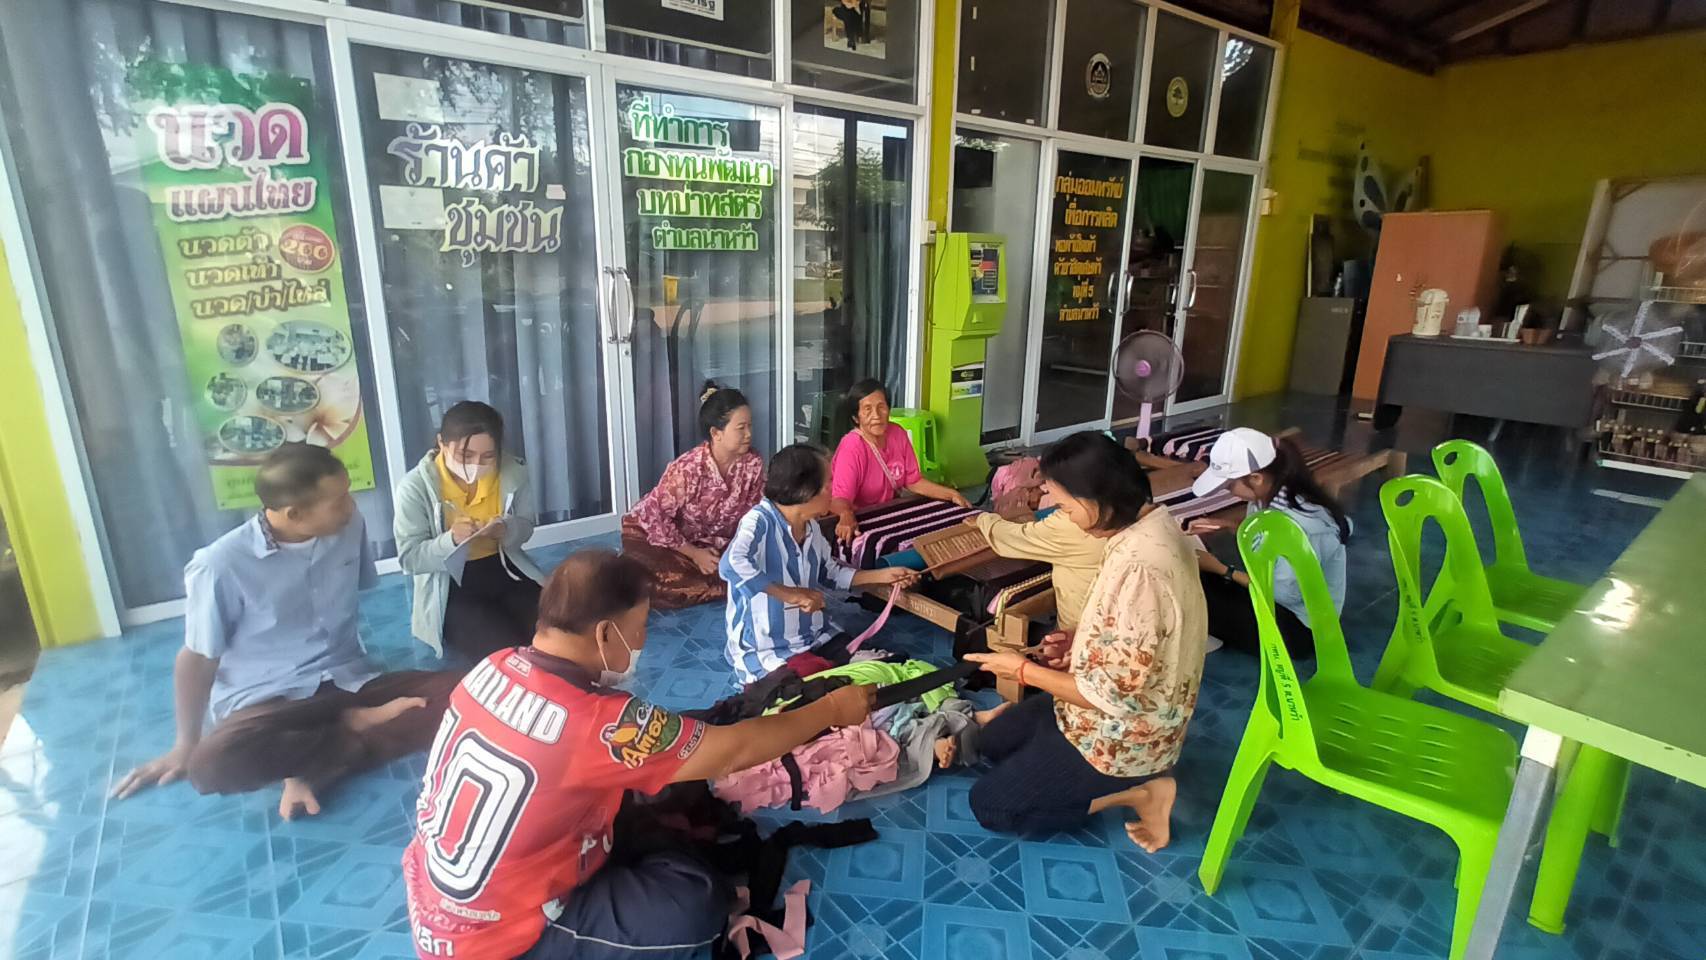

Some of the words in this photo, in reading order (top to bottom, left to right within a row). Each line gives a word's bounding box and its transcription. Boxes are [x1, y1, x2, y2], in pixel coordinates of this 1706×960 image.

[148, 104, 309, 168] นวด
[631, 95, 729, 146] ที่ทำการ
[388, 123, 540, 192] ร้านค้า
[625, 147, 773, 187] กองทุนพัฒนา
[165, 167, 316, 220] แผนไทย
[637, 185, 762, 219] บทบาทสตรี
[280, 239, 328, 260] 200
[440, 197, 563, 267] ชุมชน
[652, 220, 758, 250] ตำบลนาหว้า
